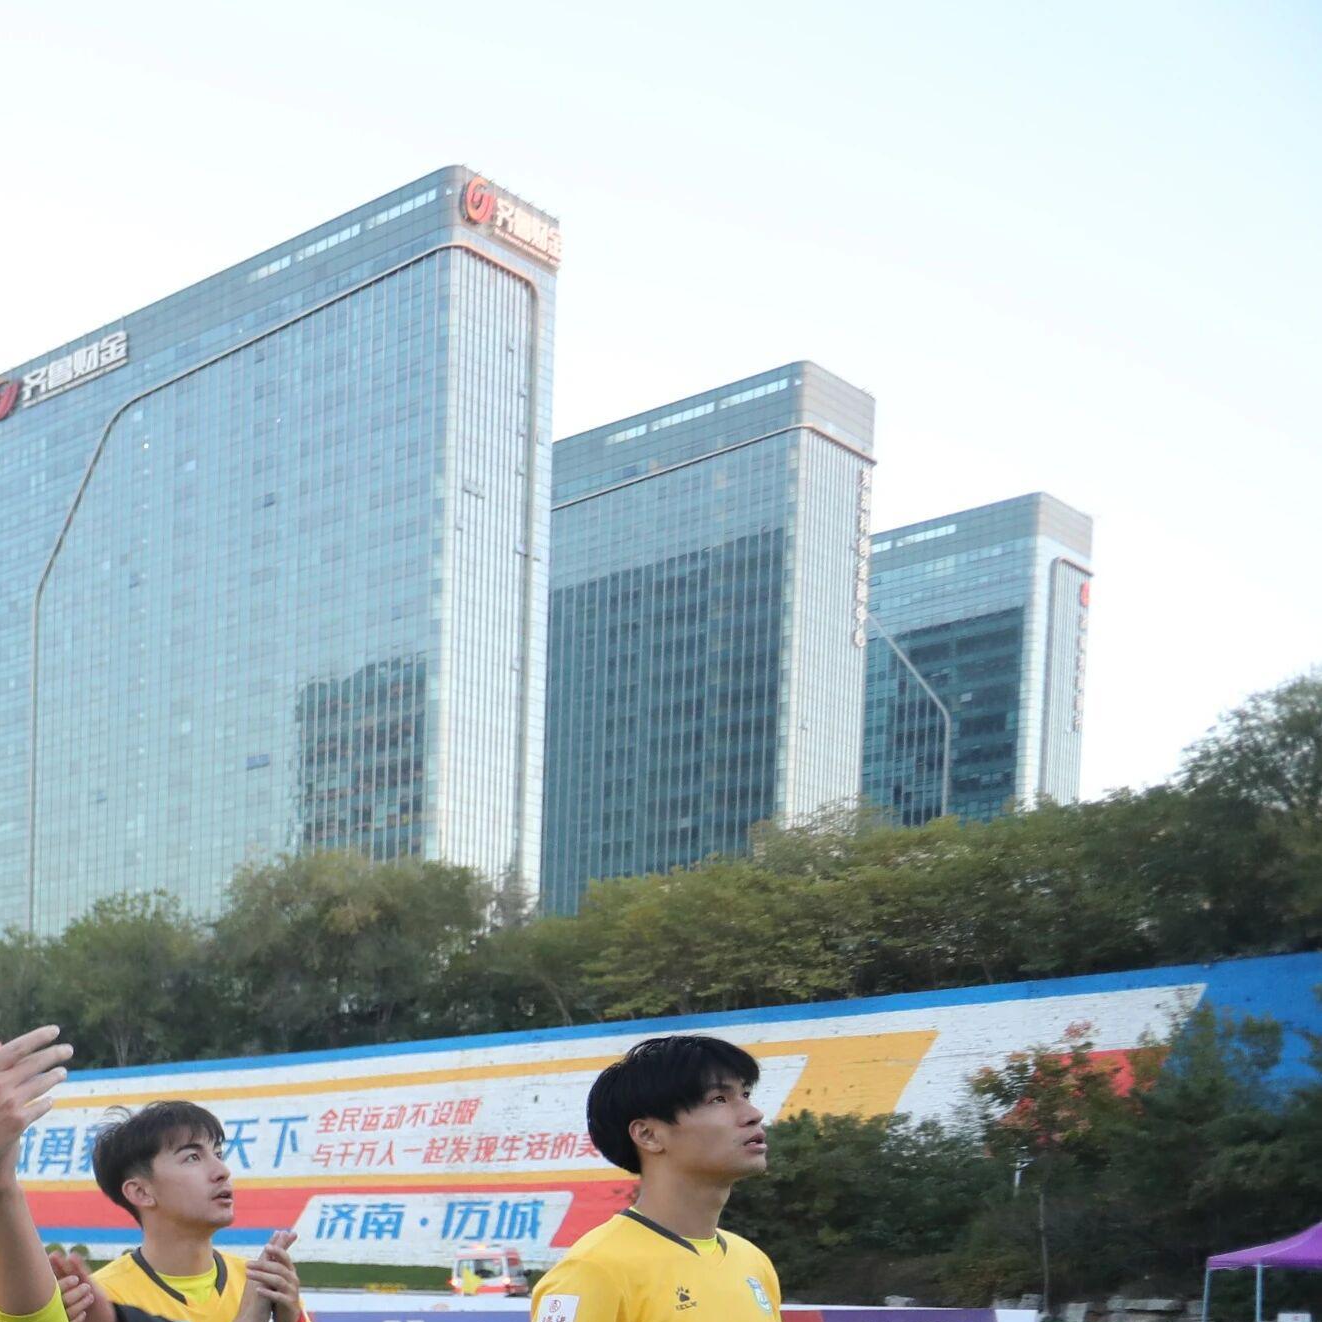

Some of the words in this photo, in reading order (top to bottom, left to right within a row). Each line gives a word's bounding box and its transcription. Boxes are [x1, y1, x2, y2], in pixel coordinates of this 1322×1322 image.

[22, 331, 128, 401] 齐鲁财金
[316, 1096, 484, 1133] 全民运动不设限
